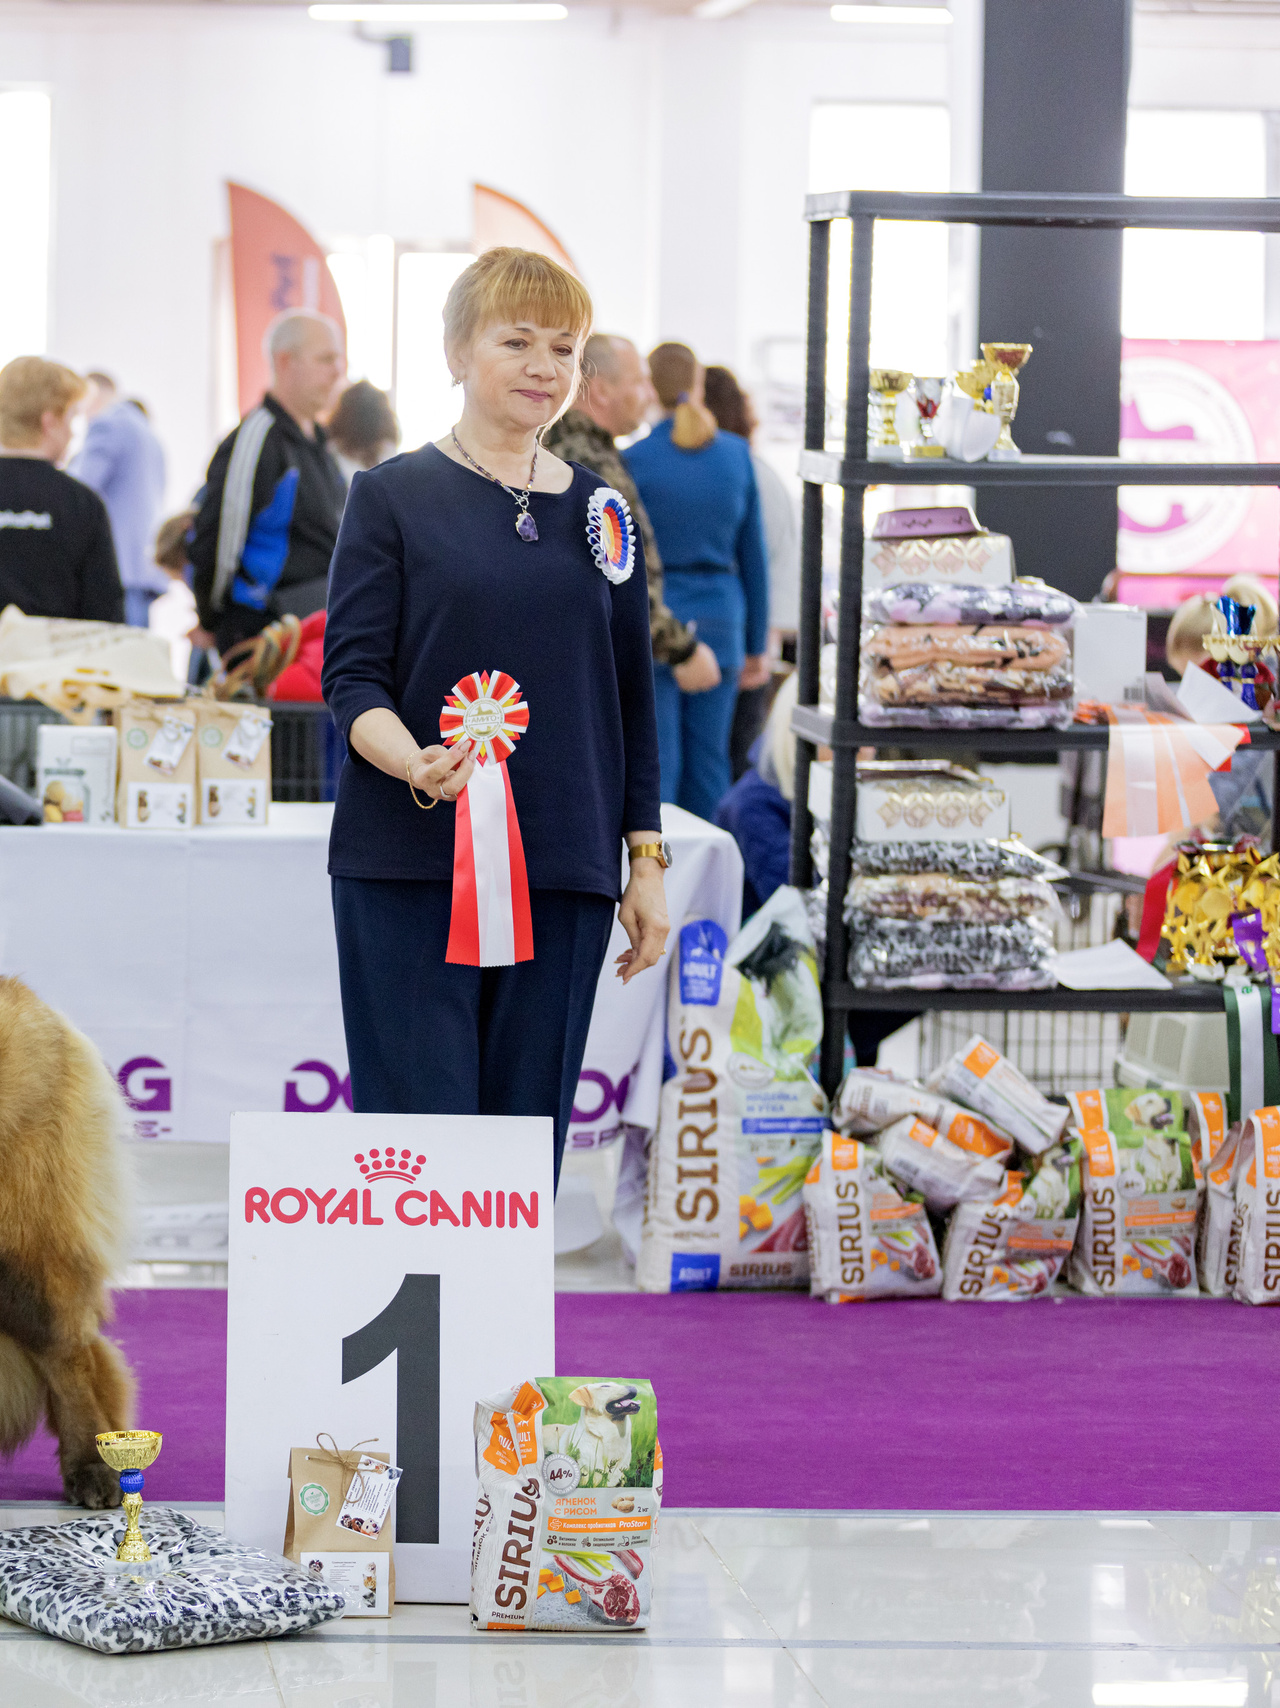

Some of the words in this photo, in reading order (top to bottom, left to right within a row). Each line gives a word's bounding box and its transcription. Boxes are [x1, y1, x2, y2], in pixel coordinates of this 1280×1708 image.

[675, 1027, 720, 1223] SIRIUS
[244, 1186, 384, 1226] ROYAL
[394, 1189, 539, 1229] CANIN
[835, 1180, 865, 1285] SIRIUS
[1092, 1186, 1116, 1287] SIRIUS
[959, 1206, 1009, 1297] SIRIUS
[729, 1262, 794, 1277] SIRIUS
[341, 1273, 441, 1544] 1
[549, 1467, 573, 1481] 44%
[554, 1507, 562, 1516] С
[563, 1507, 598, 1516] РИСОМ
[555, 1497, 597, 1506] ЯГНЕНОК
[587, 1522, 617, 1530] пробиотиков
[491, 1610, 525, 1620] PREMIUM
